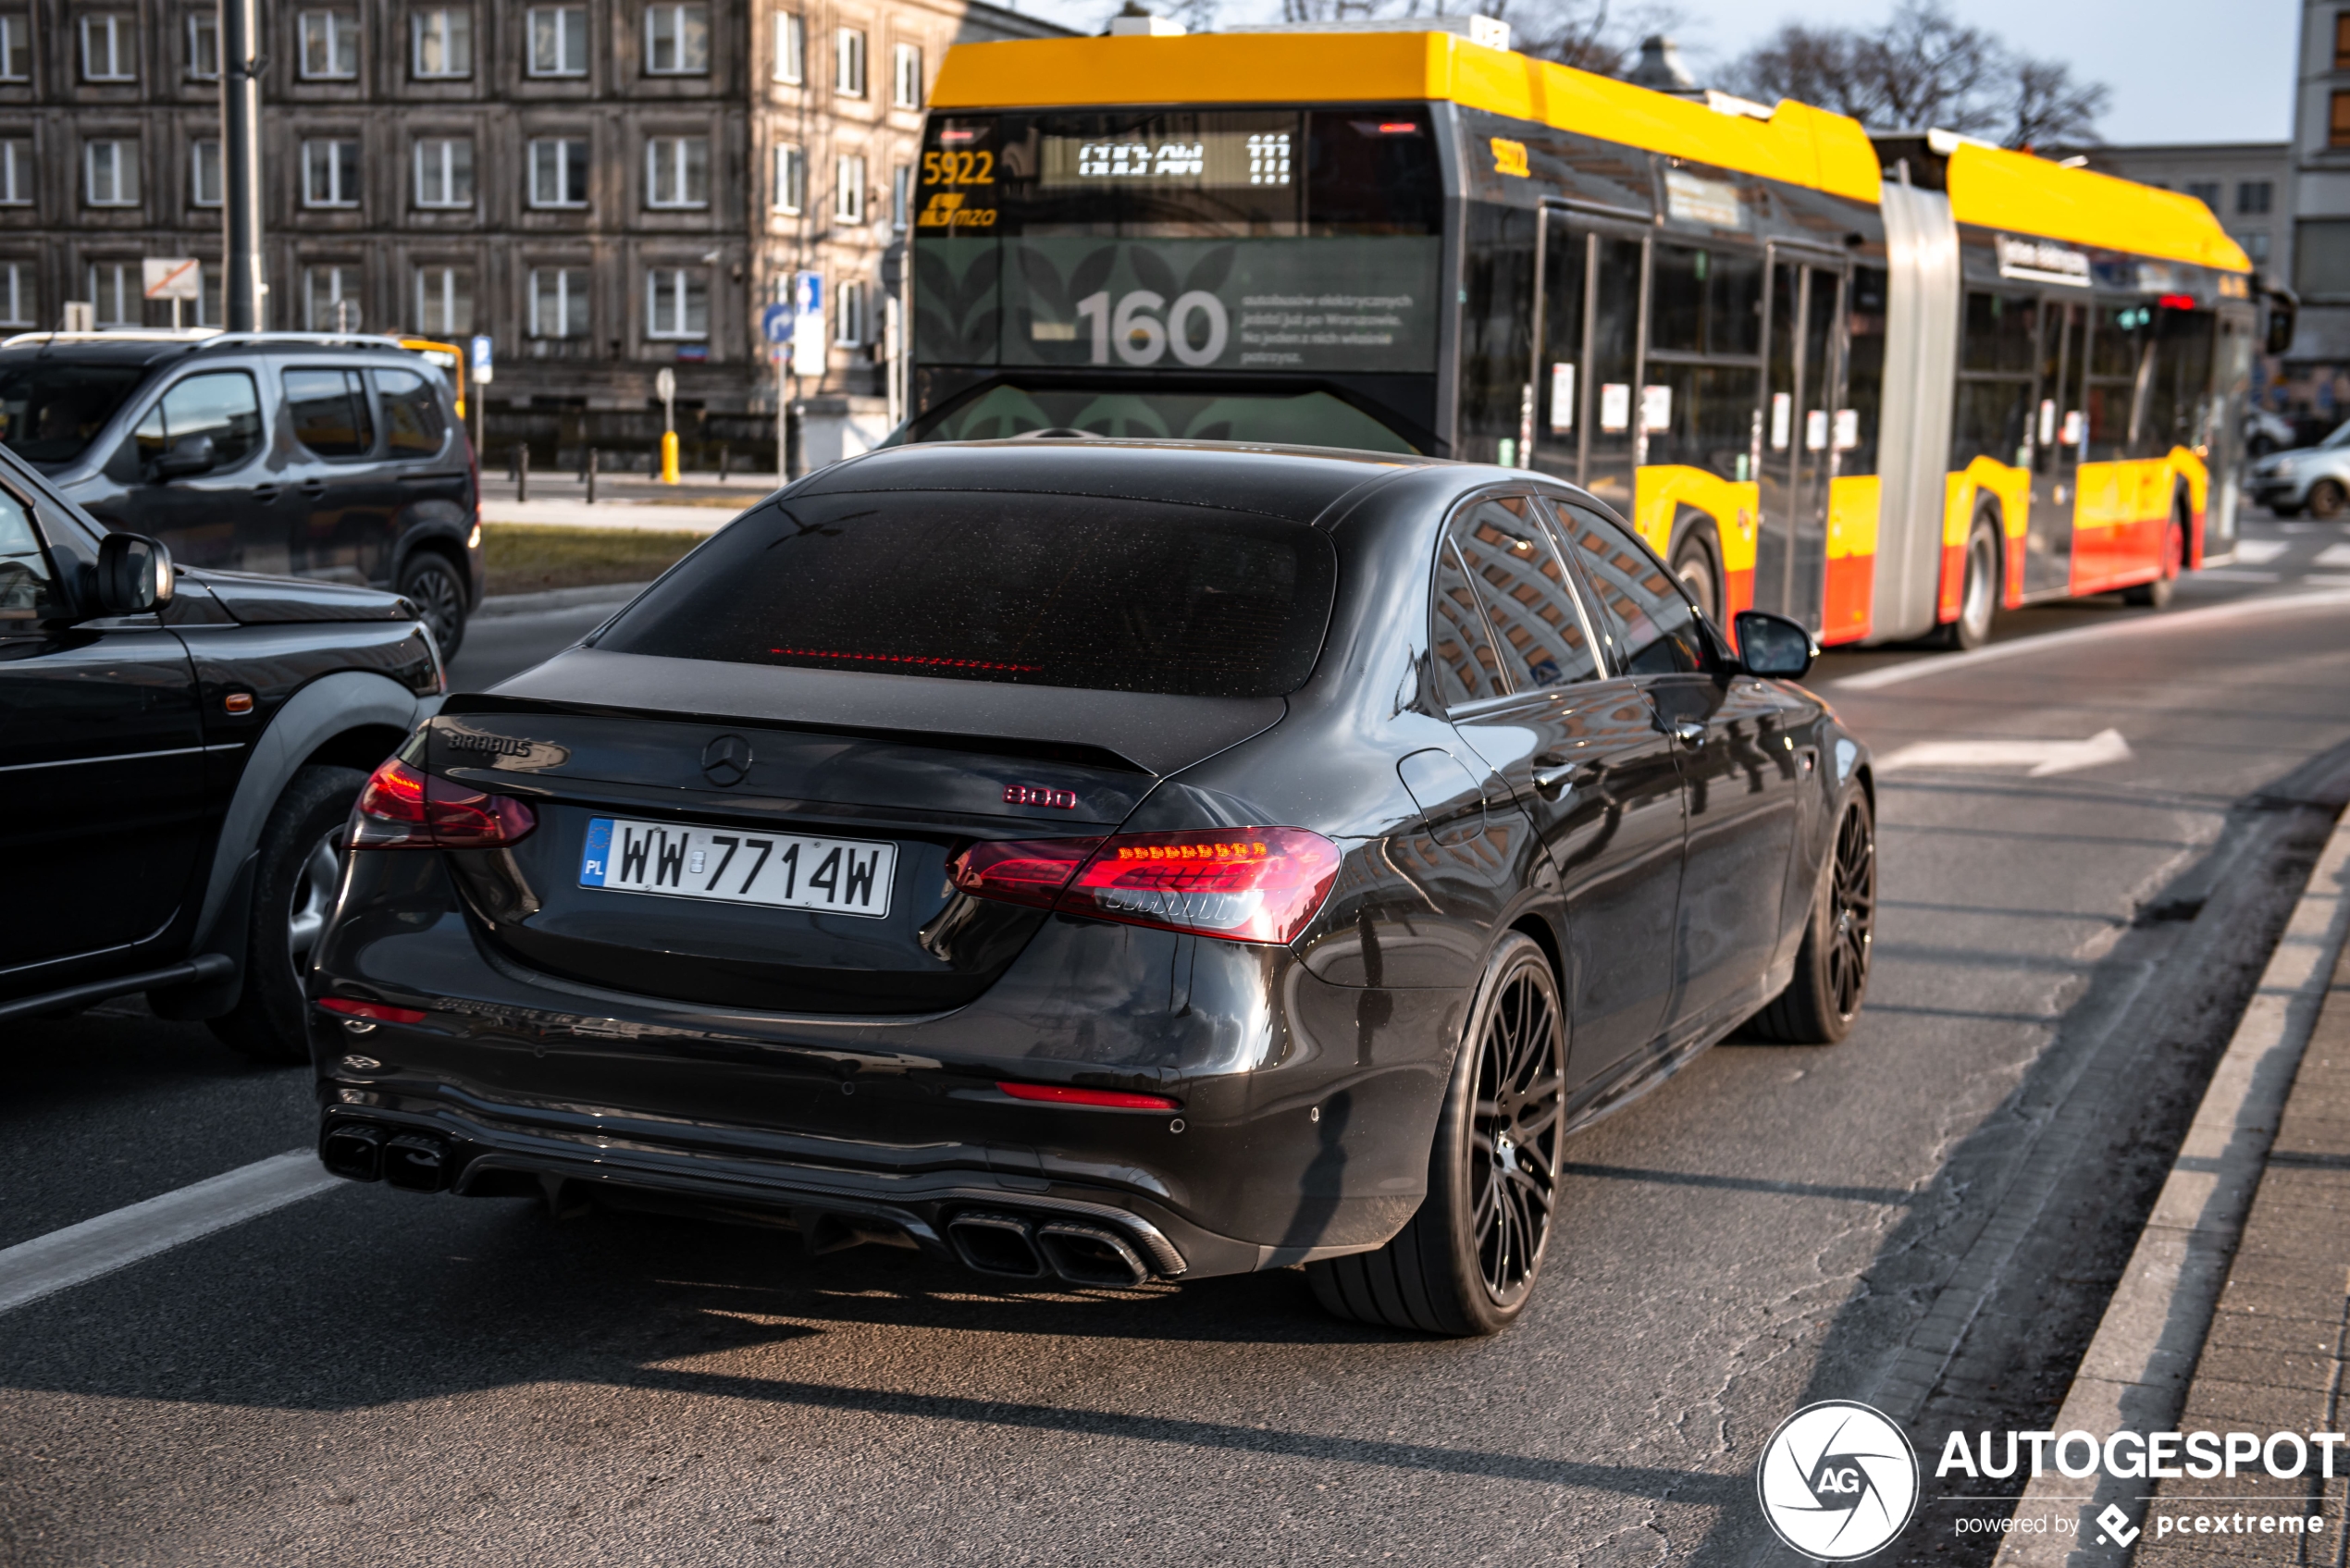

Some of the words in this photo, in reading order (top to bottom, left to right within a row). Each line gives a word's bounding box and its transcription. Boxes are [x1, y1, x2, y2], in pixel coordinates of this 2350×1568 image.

[923, 151, 995, 185] 5922
[1076, 290, 1229, 366] 160
[448, 734, 532, 758] BRABUS
[1002, 784, 1076, 809] 800
[585, 859, 604, 876] PL
[619, 827, 690, 888] WW
[705, 835, 880, 907] 7714W
